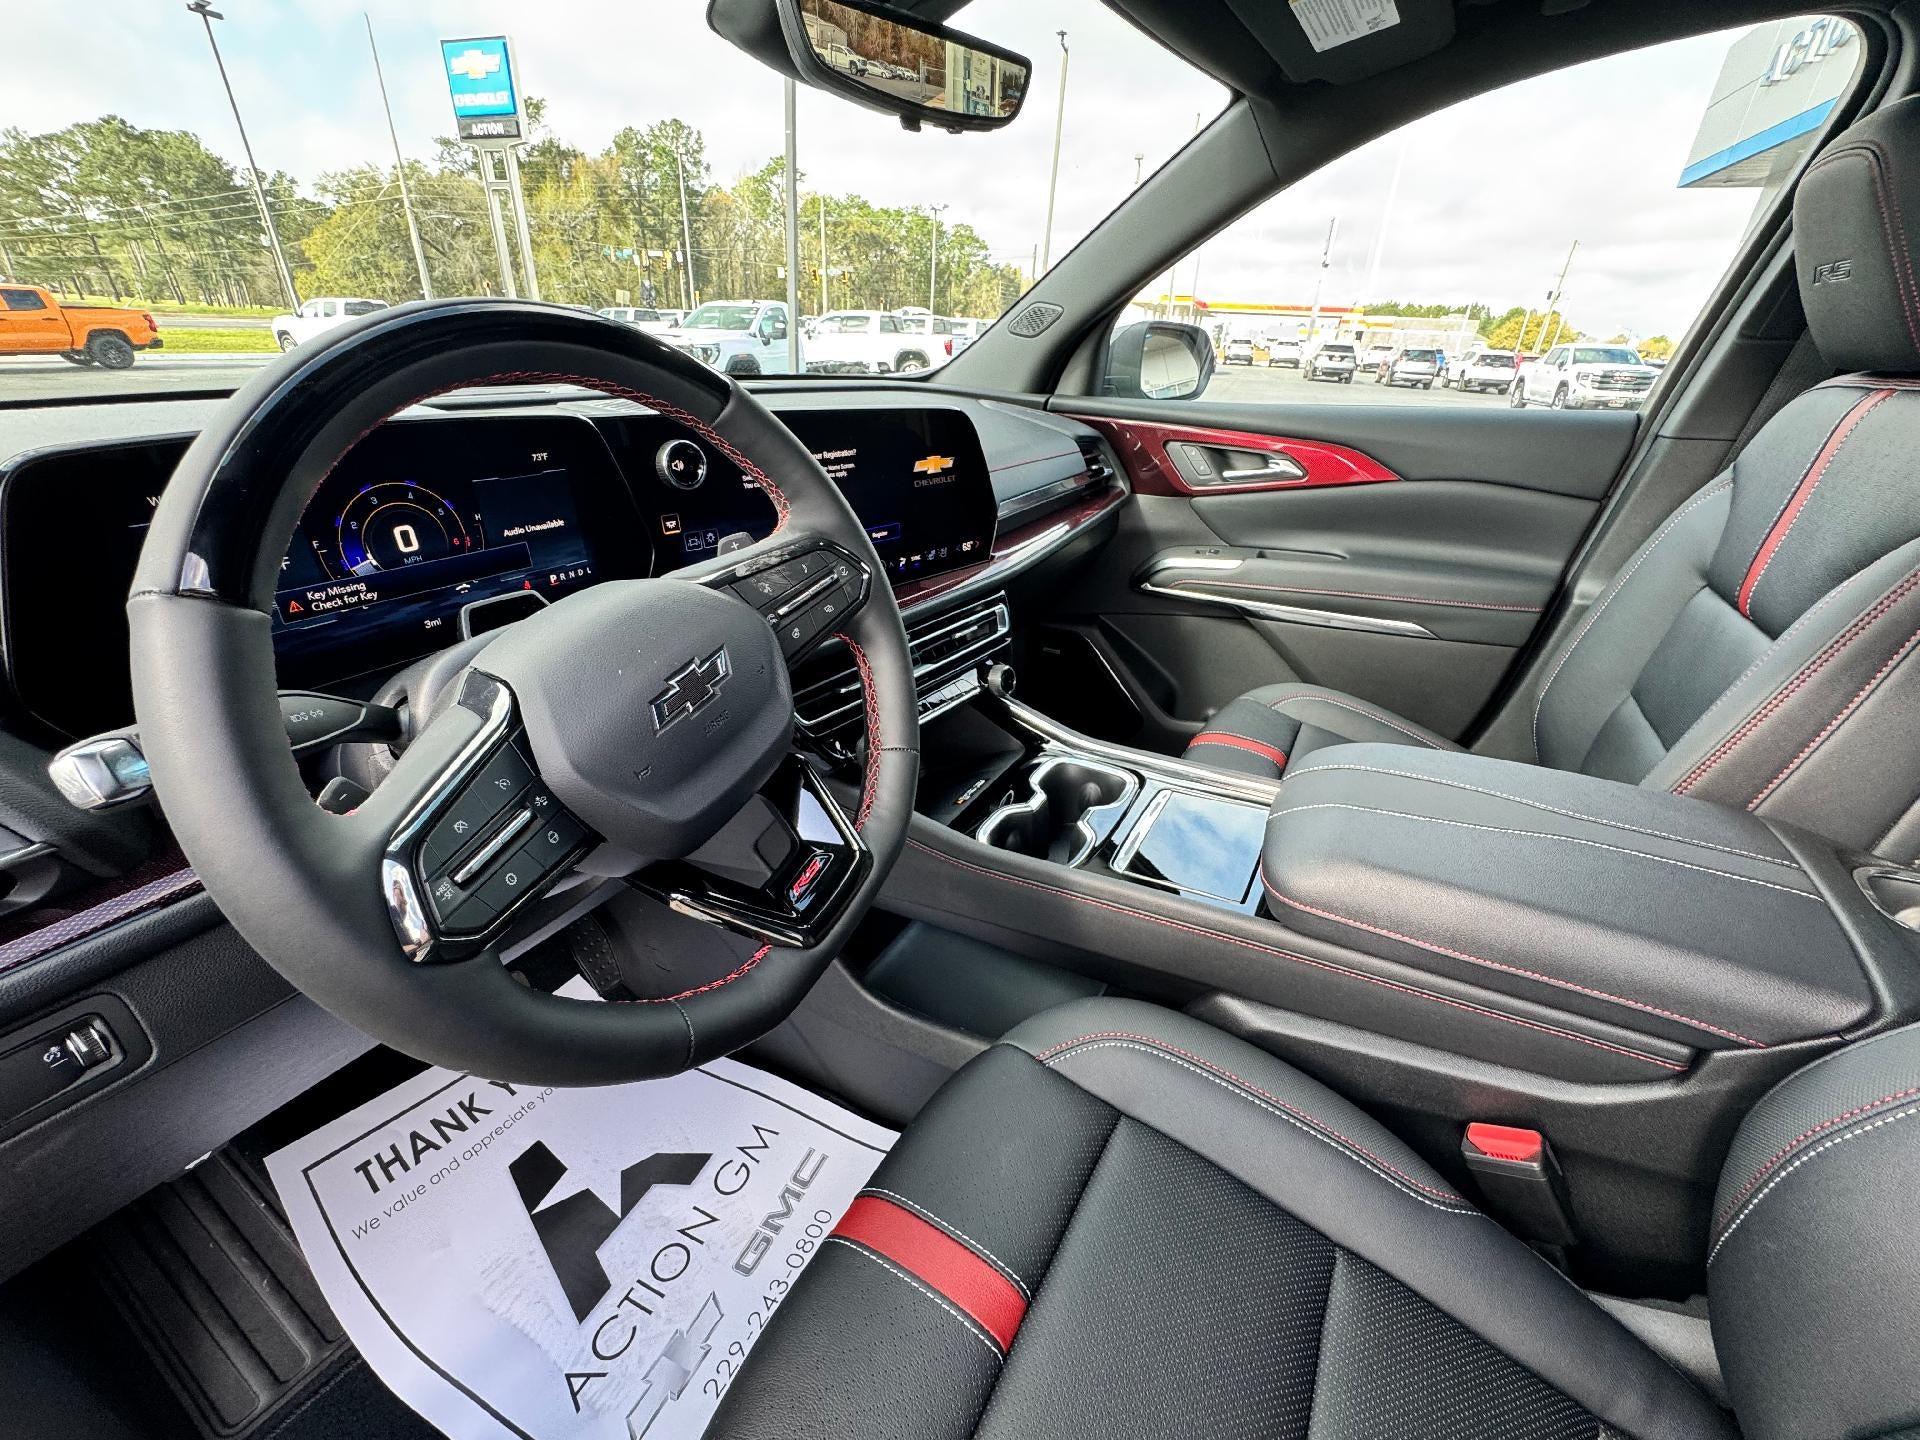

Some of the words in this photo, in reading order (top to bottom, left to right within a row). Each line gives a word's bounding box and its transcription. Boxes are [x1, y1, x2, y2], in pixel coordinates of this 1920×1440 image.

[471, 121, 505, 136] ACTION
[1813, 259, 1851, 285] RS
[914, 474, 956, 488] CHEVROLET
[370, 496, 378, 505] 3
[408, 492, 414, 500] 4
[350, 521, 359, 530] 2
[504, 526, 525, 537] Audio
[526, 519, 564, 532] Unavailable
[393, 524, 420, 552] 0
[403, 555, 422, 564] MPH
[550, 574, 558, 584] P
[560, 572, 567, 580] R
[568, 570, 576, 578] N
[306, 590, 327, 601] Key
[328, 582, 366, 596] Missing
[312, 600, 344, 612] Check
[344, 594, 360, 606] for
[360, 590, 378, 602] Key
[792, 857, 822, 897] RS
[354, 1092, 494, 1194] THANK
[488, 1080, 518, 1097] Y
[351, 1216, 381, 1240] We
[382, 1184, 427, 1218] value
[430, 1156, 460, 1185] and
[462, 1100, 536, 1162] appreciate
[536, 1087, 557, 1103] yo
[732, 1146, 829, 1278] GMC
[564, 1206, 720, 1414] ACTION
[714, 1124, 780, 1196] GM
[703, 1209, 832, 1400] 229-243-0800
